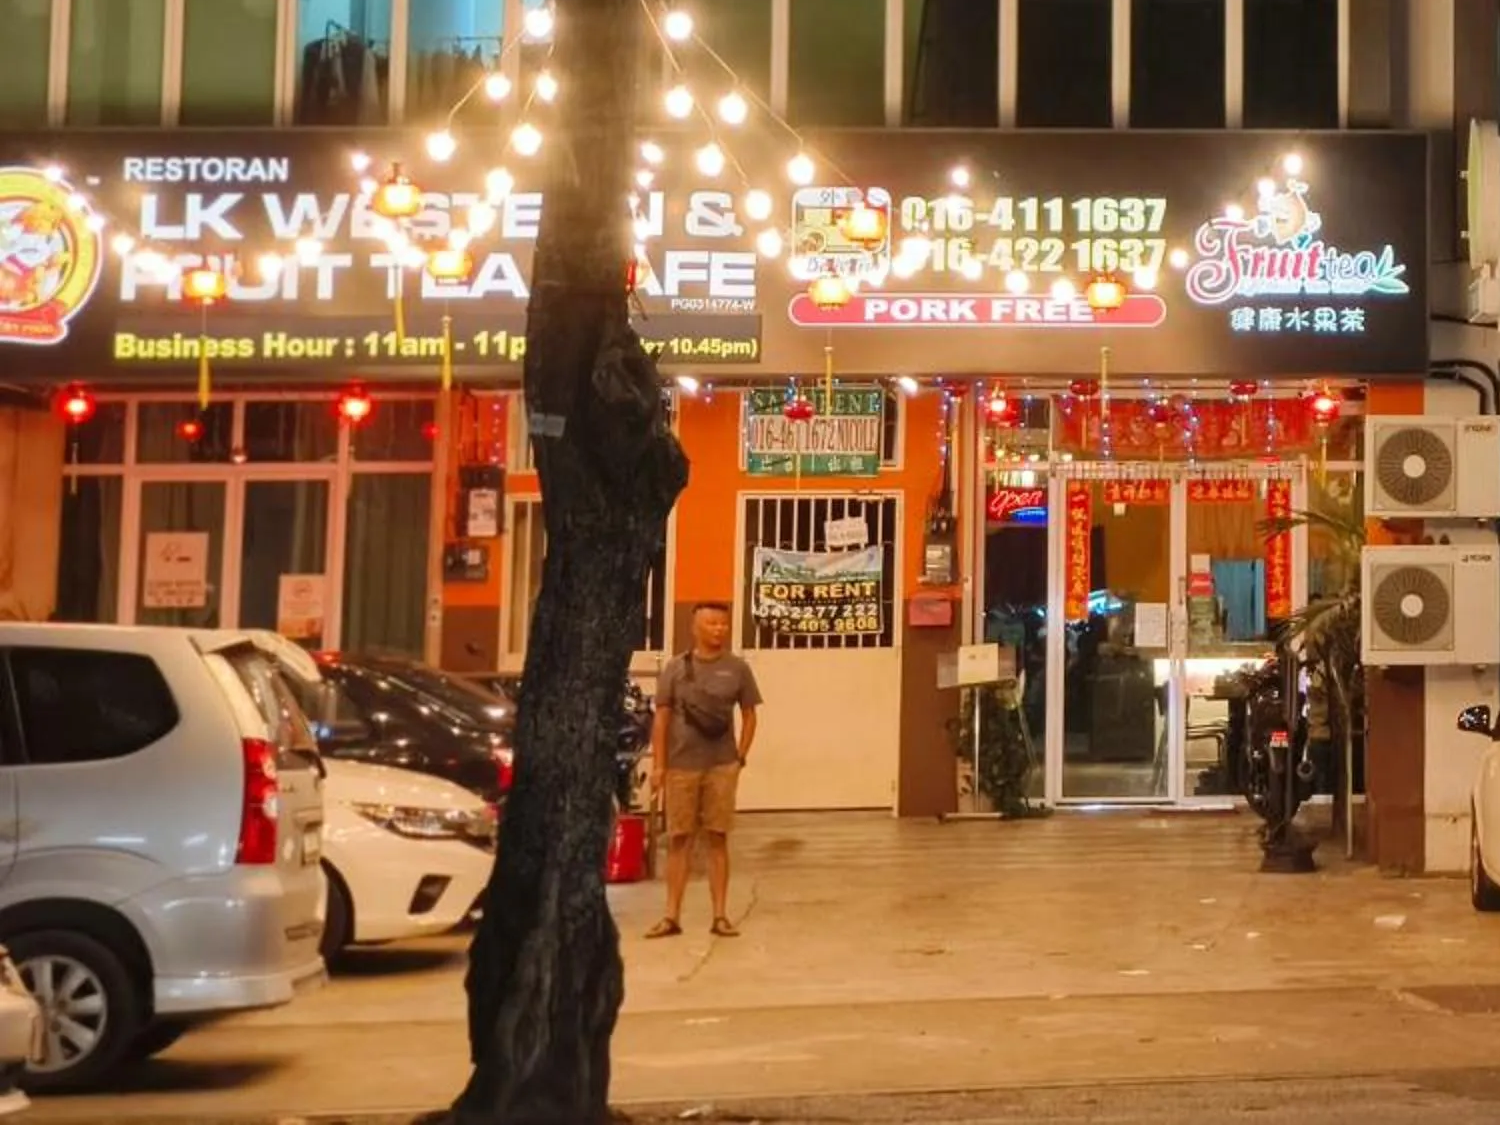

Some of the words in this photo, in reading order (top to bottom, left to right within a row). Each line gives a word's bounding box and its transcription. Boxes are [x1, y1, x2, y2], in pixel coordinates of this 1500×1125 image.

[123, 157, 289, 183] RESTORAN
[140, 192, 245, 239] LK
[685, 190, 744, 237] &
[1071, 197, 1168, 233] 1637
[905, 238, 1066, 273] 16-422
[1071, 238, 1168, 273] 1637
[863, 298, 979, 322] PORK
[990, 298, 1095, 322] FREE
[114, 332, 255, 360] Business
[262, 332, 340, 360] Hour
[363, 331, 445, 359] 11am
[472, 332, 527, 363] 11p
[759, 584, 806, 600] FOR
[813, 582, 876, 599] RENT
